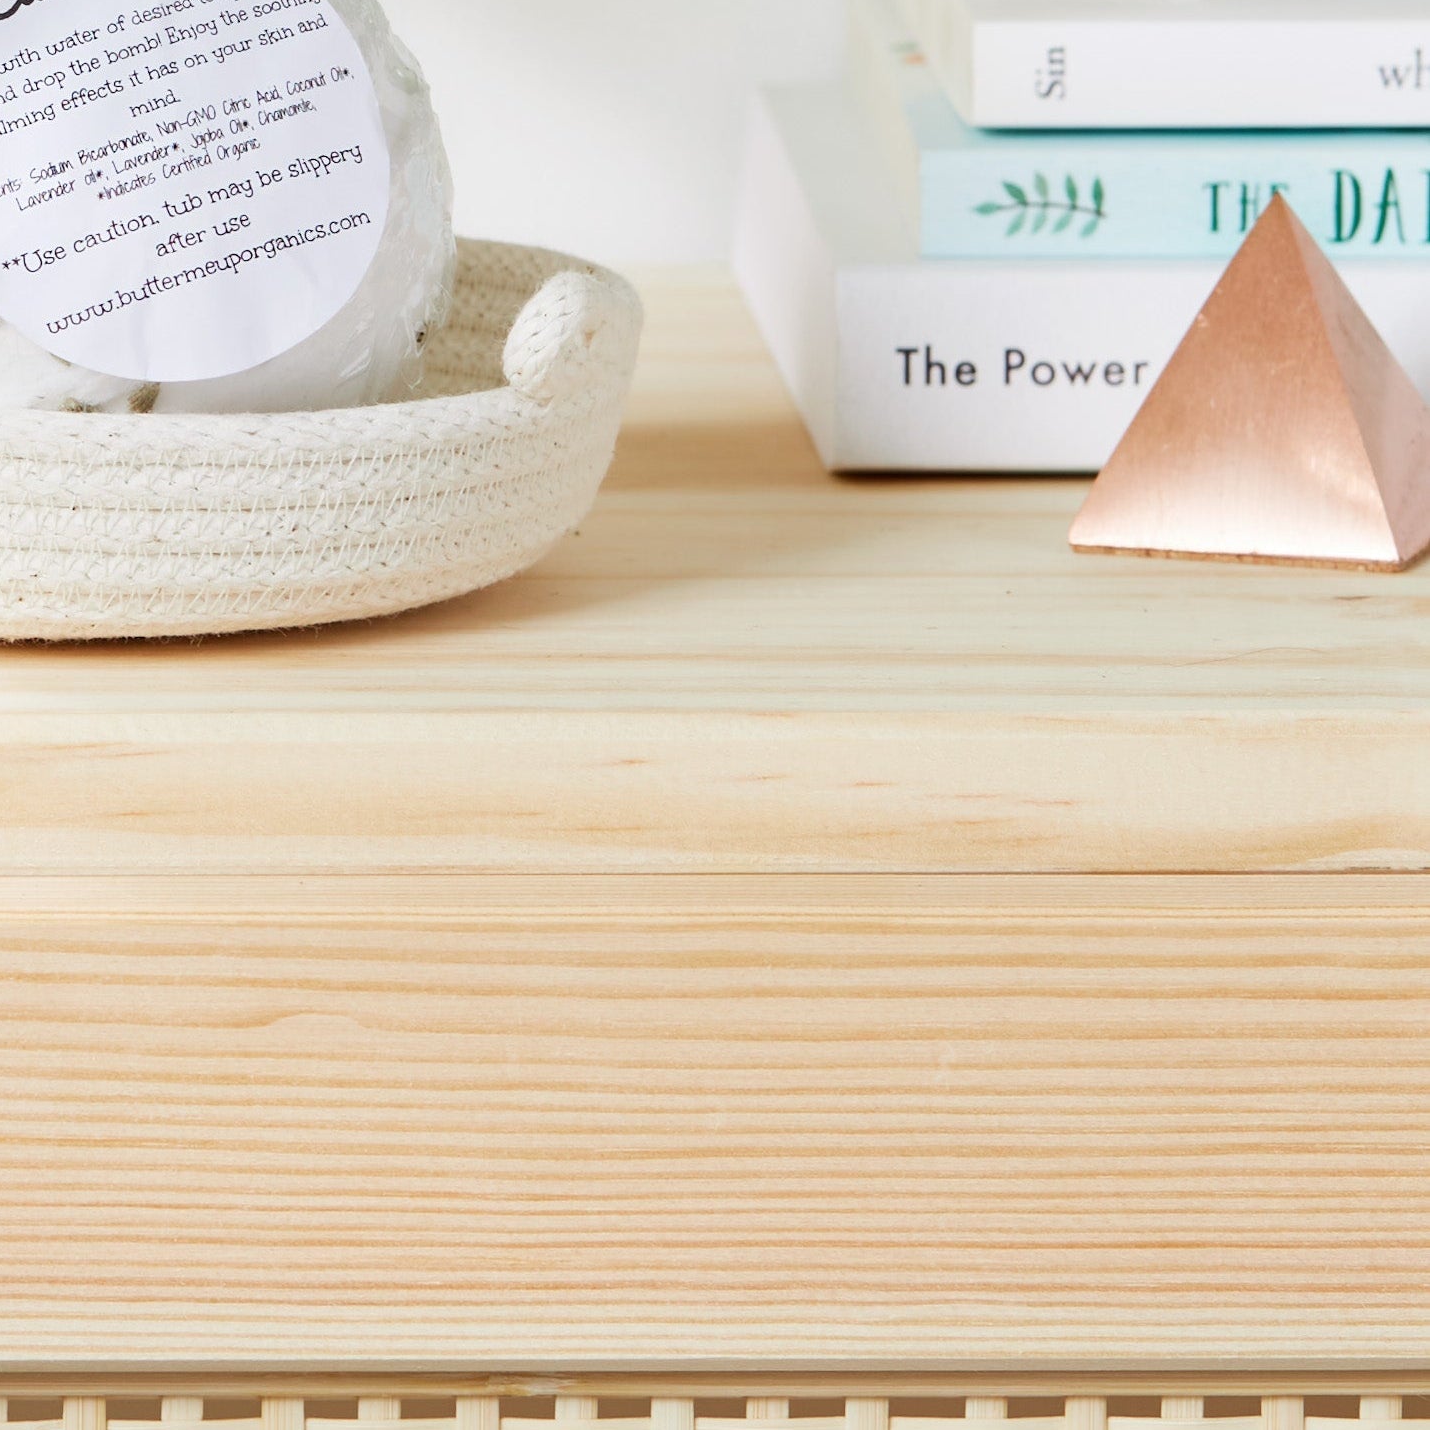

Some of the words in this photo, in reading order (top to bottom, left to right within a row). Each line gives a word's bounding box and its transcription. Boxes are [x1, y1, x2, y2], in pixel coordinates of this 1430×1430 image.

[22, 70, 67, 95] drop
[68, 55, 102, 77] the
[105, 32, 162, 65] bomb!
[165, 18, 219, 46] Enjoy
[219, 10, 249, 29] the
[46, 29, 101, 57] water
[107, 15, 126, 35] of
[61, 77, 124, 111] effects
[129, 70, 143, 88] it
[145, 61, 179, 84] has
[184, 53, 209, 68] on
[212, 37, 254, 63] your
[259, 28, 295, 46] skin
[299, 13, 329, 34] and
[30, 159, 73, 184] Sodium
[78, 131, 154, 165] Bicarbonate,
[156, 105, 216, 136] Non-GMO
[223, 97, 251, 116] Citric
[286, 74, 326, 96] Coconut
[130, 90, 181, 118] mind.
[16, 180, 76, 211] Lavender
[190, 127, 225, 151] Jojoba
[162, 193, 203, 219] tub
[207, 178, 254, 204] may
[256, 168, 283, 188] be
[288, 145, 363, 178] slippery
[163, 148, 212, 179] Certified
[216, 136, 261, 161] Organic
[155, 229, 207, 257] after
[212, 213, 252, 237] use
[1202, 180, 1290, 234] TH
[46, 211, 371, 334] www.buttermeuporganics.com
[895, 343, 977, 386] The
[1003, 347, 1149, 386] Power
